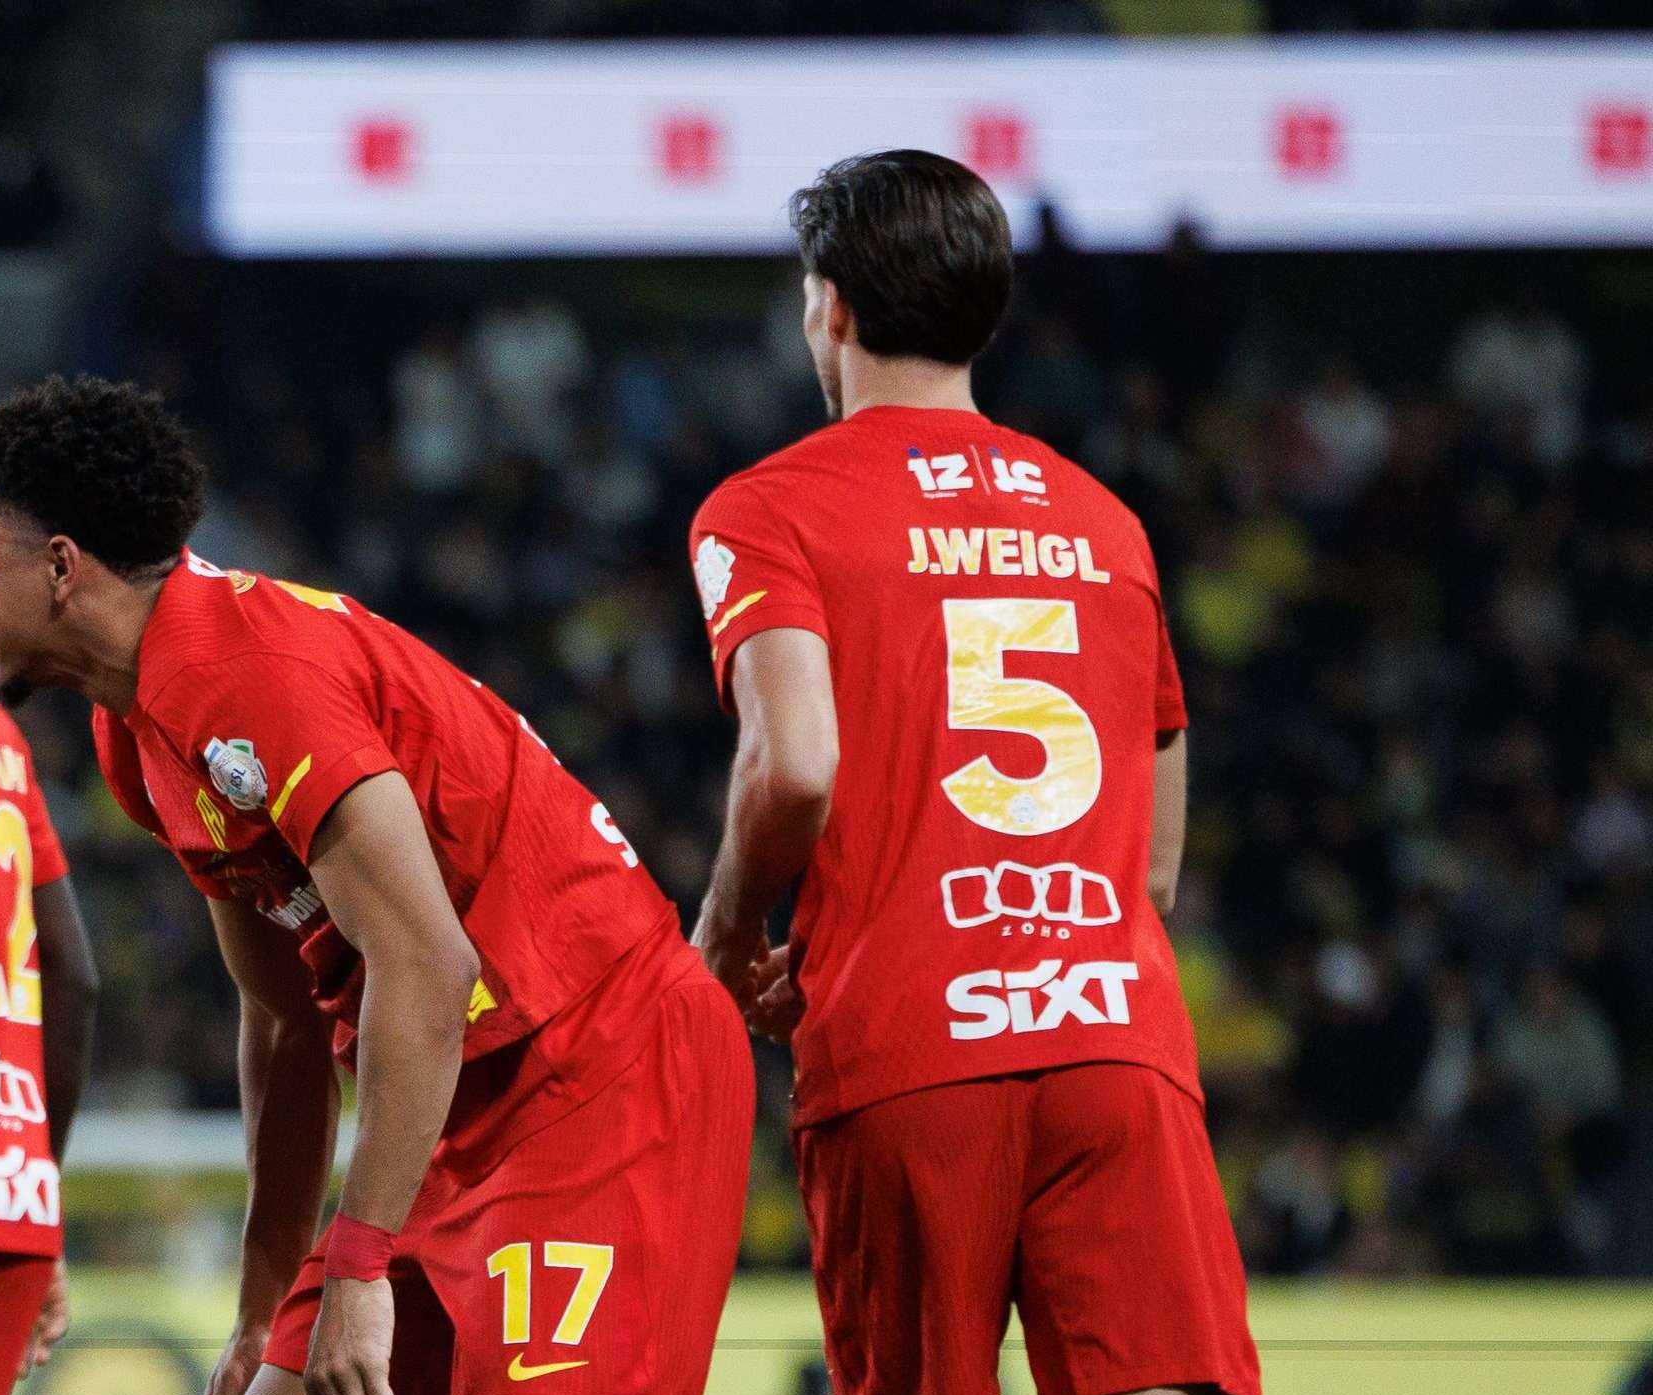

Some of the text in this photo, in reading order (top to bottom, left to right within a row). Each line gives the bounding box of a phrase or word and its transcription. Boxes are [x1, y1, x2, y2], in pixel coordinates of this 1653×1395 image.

[907, 527, 1111, 584] J.WEIGL
[940, 598, 1102, 836] 5
[1001, 922, 1071, 940] ZOHO
[487, 1240, 613, 1346] 17
